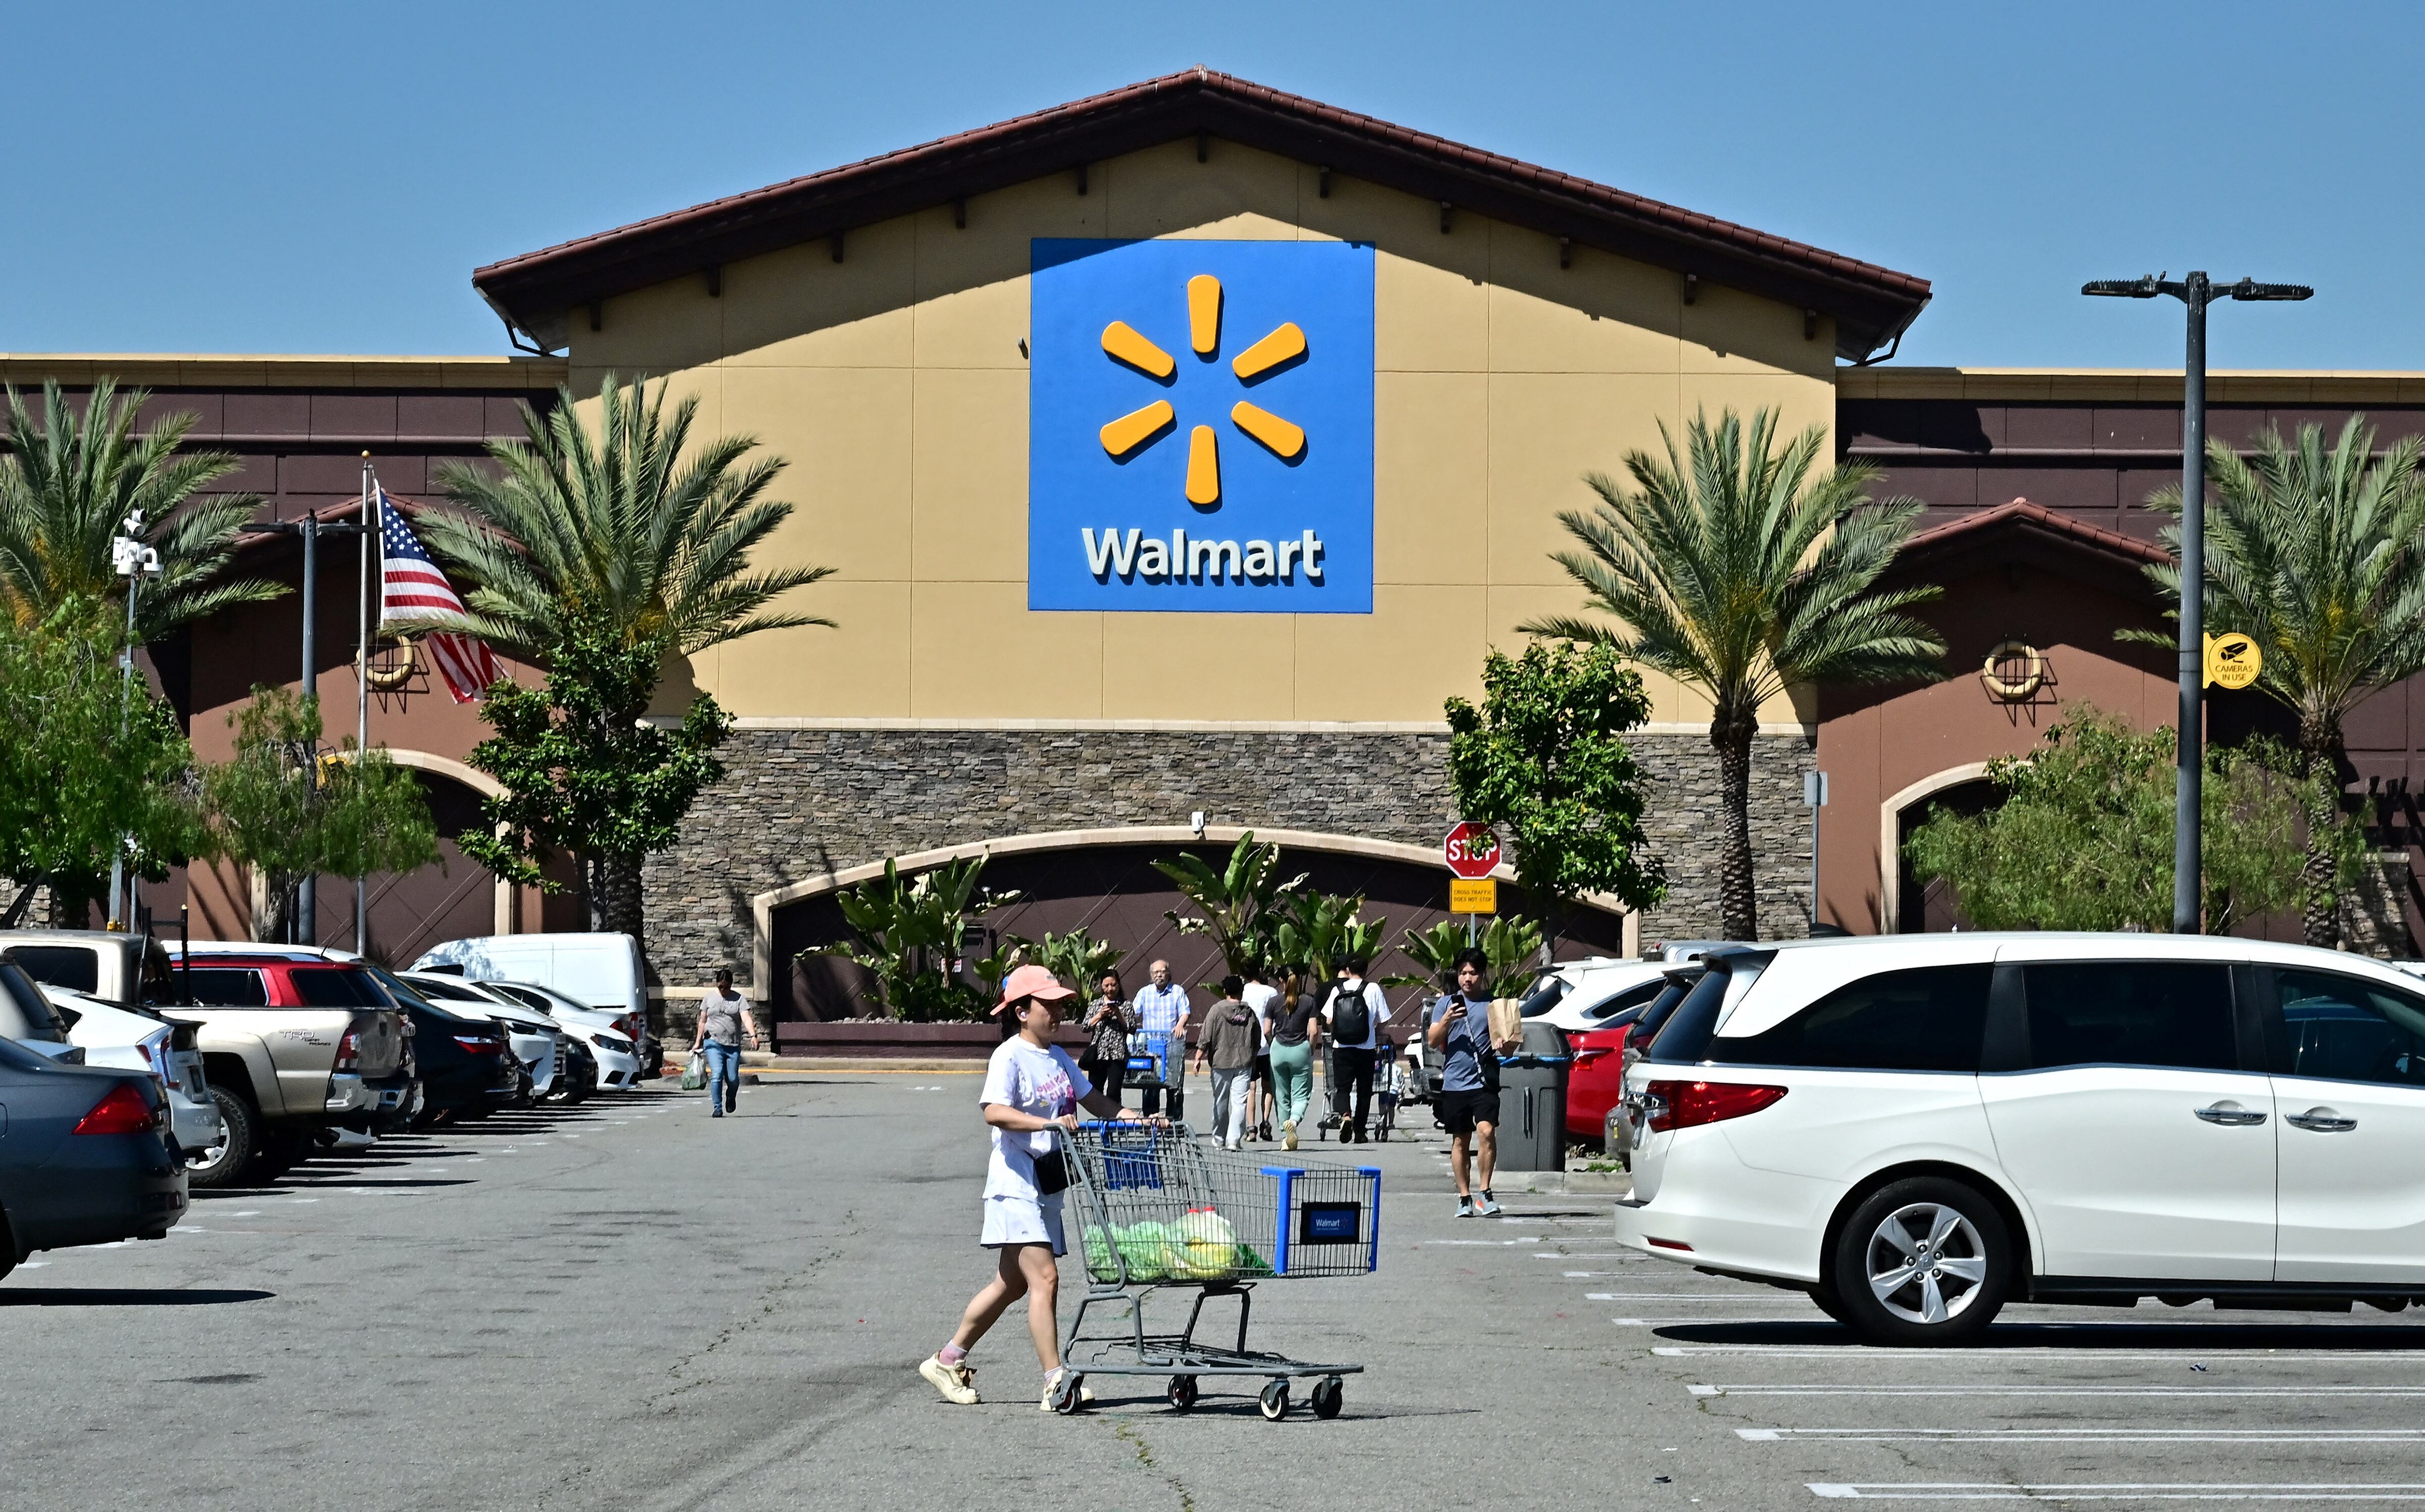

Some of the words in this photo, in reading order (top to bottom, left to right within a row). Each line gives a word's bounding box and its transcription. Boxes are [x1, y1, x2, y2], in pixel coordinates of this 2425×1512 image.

[1082, 528, 1322, 576] Walmart
[279, 1029, 314, 1040] TRD
[1316, 1218, 1340, 1227] Walmart
